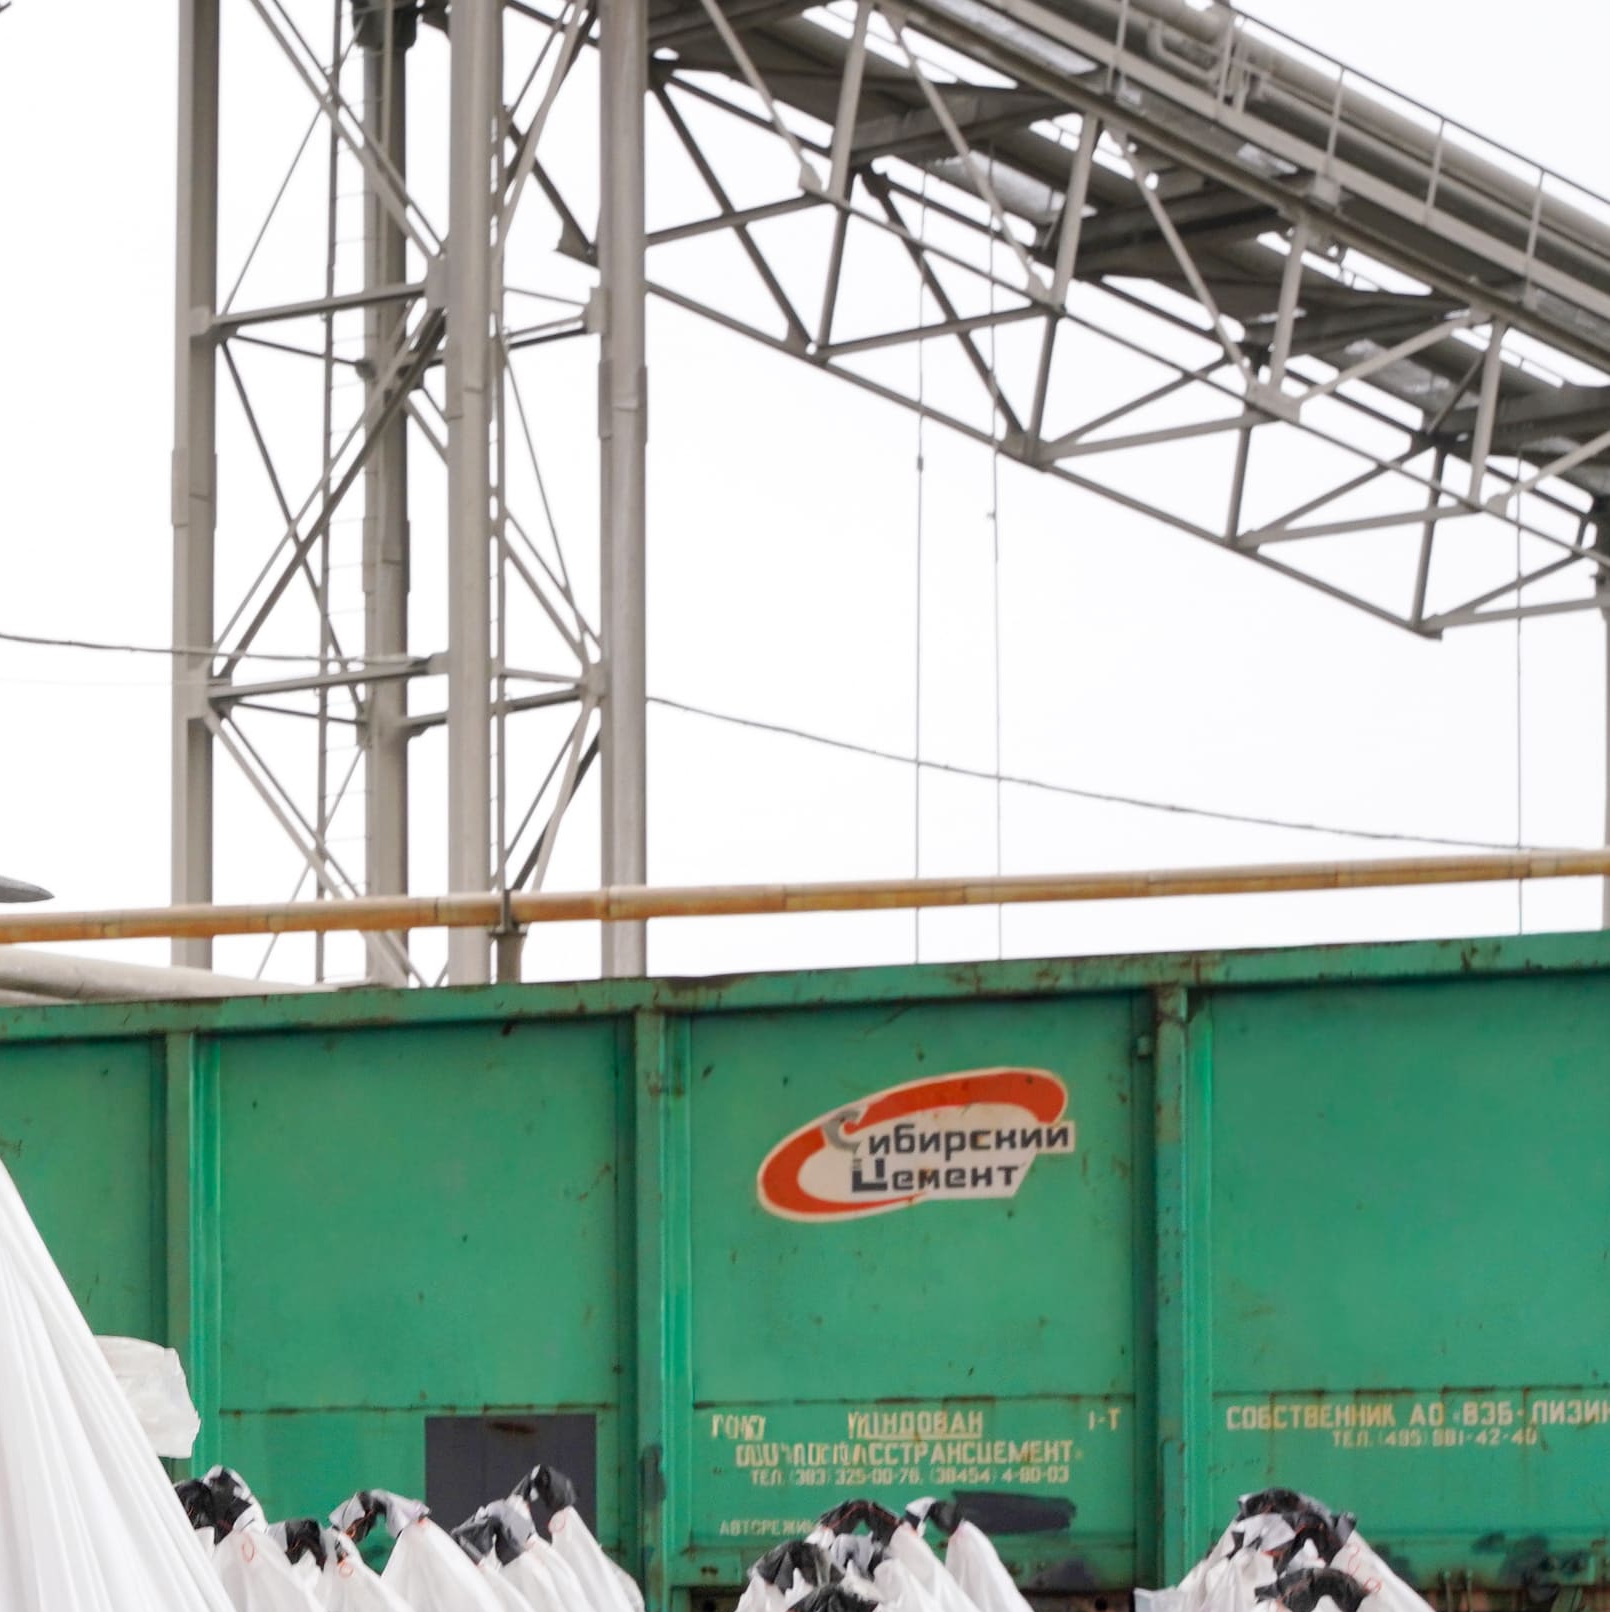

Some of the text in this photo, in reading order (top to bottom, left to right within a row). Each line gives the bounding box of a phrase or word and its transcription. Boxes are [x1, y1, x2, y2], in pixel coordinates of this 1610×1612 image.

[851, 1157, 1019, 1193] Цемент
[1225, 1404, 1396, 1431] СОБСТВЕННИК
[1409, 1403, 1445, 1427] АО
